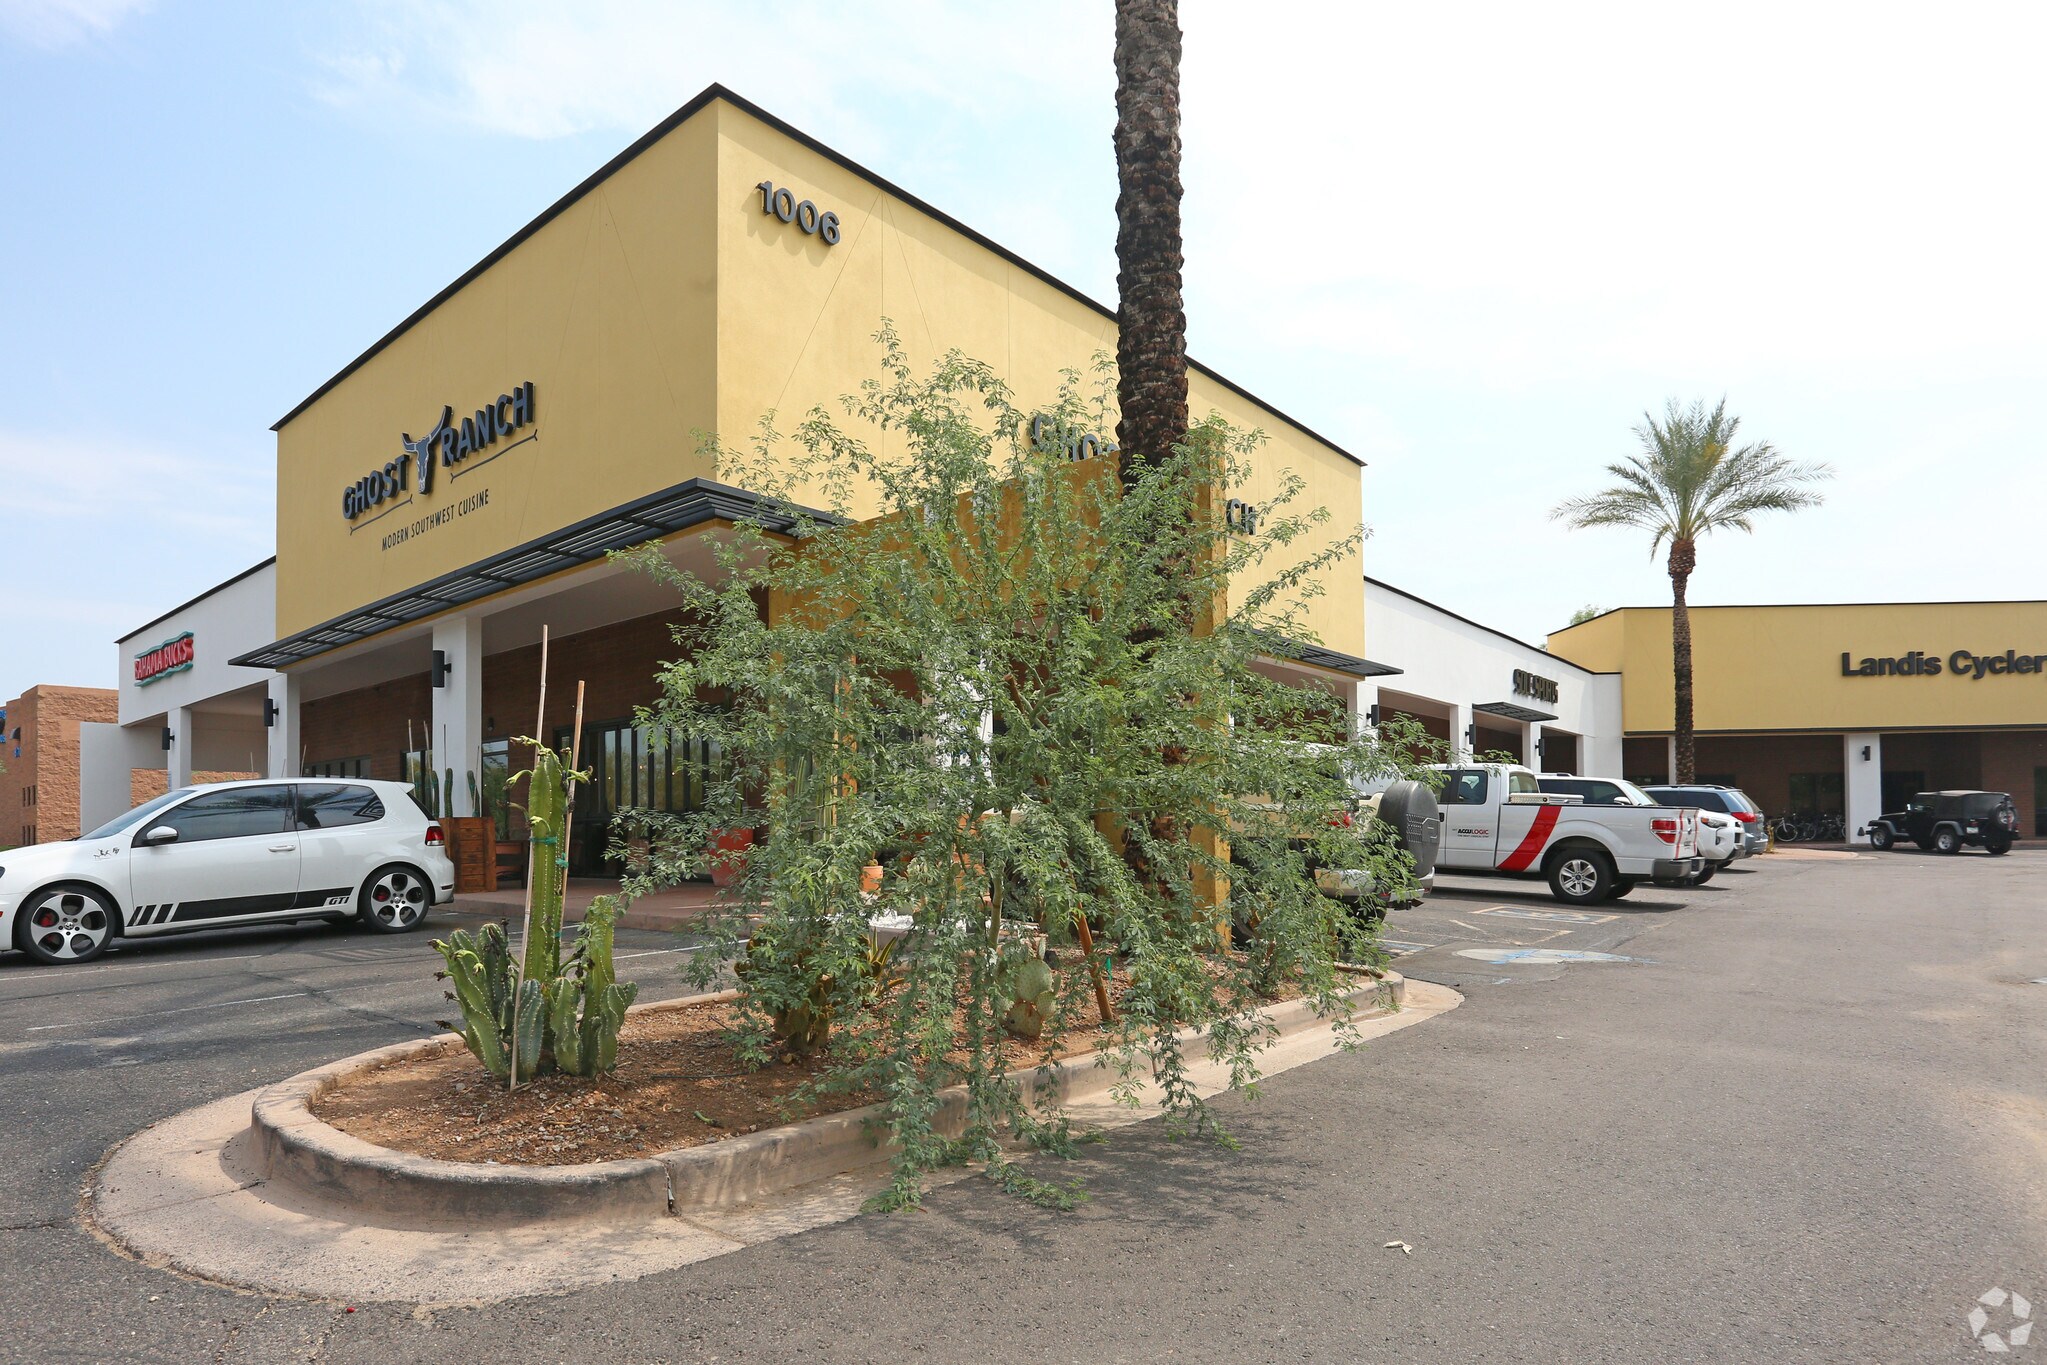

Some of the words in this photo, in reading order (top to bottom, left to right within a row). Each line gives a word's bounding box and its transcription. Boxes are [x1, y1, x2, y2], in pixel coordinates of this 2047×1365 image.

[755, 180, 840, 246] 1006
[342, 454, 410, 520] GHOST
[440, 381, 534, 467] RANCH
[381, 526, 409, 551] MODERN
[411, 504, 455, 538] SOUTHWEST
[458, 488, 489, 516] CUISINE
[134, 649, 164, 681] BAHAMA
[1841, 651, 1942, 676] Landis
[1950, 650, 2047, 679] Cycler
[328, 896, 350, 905] GTI
